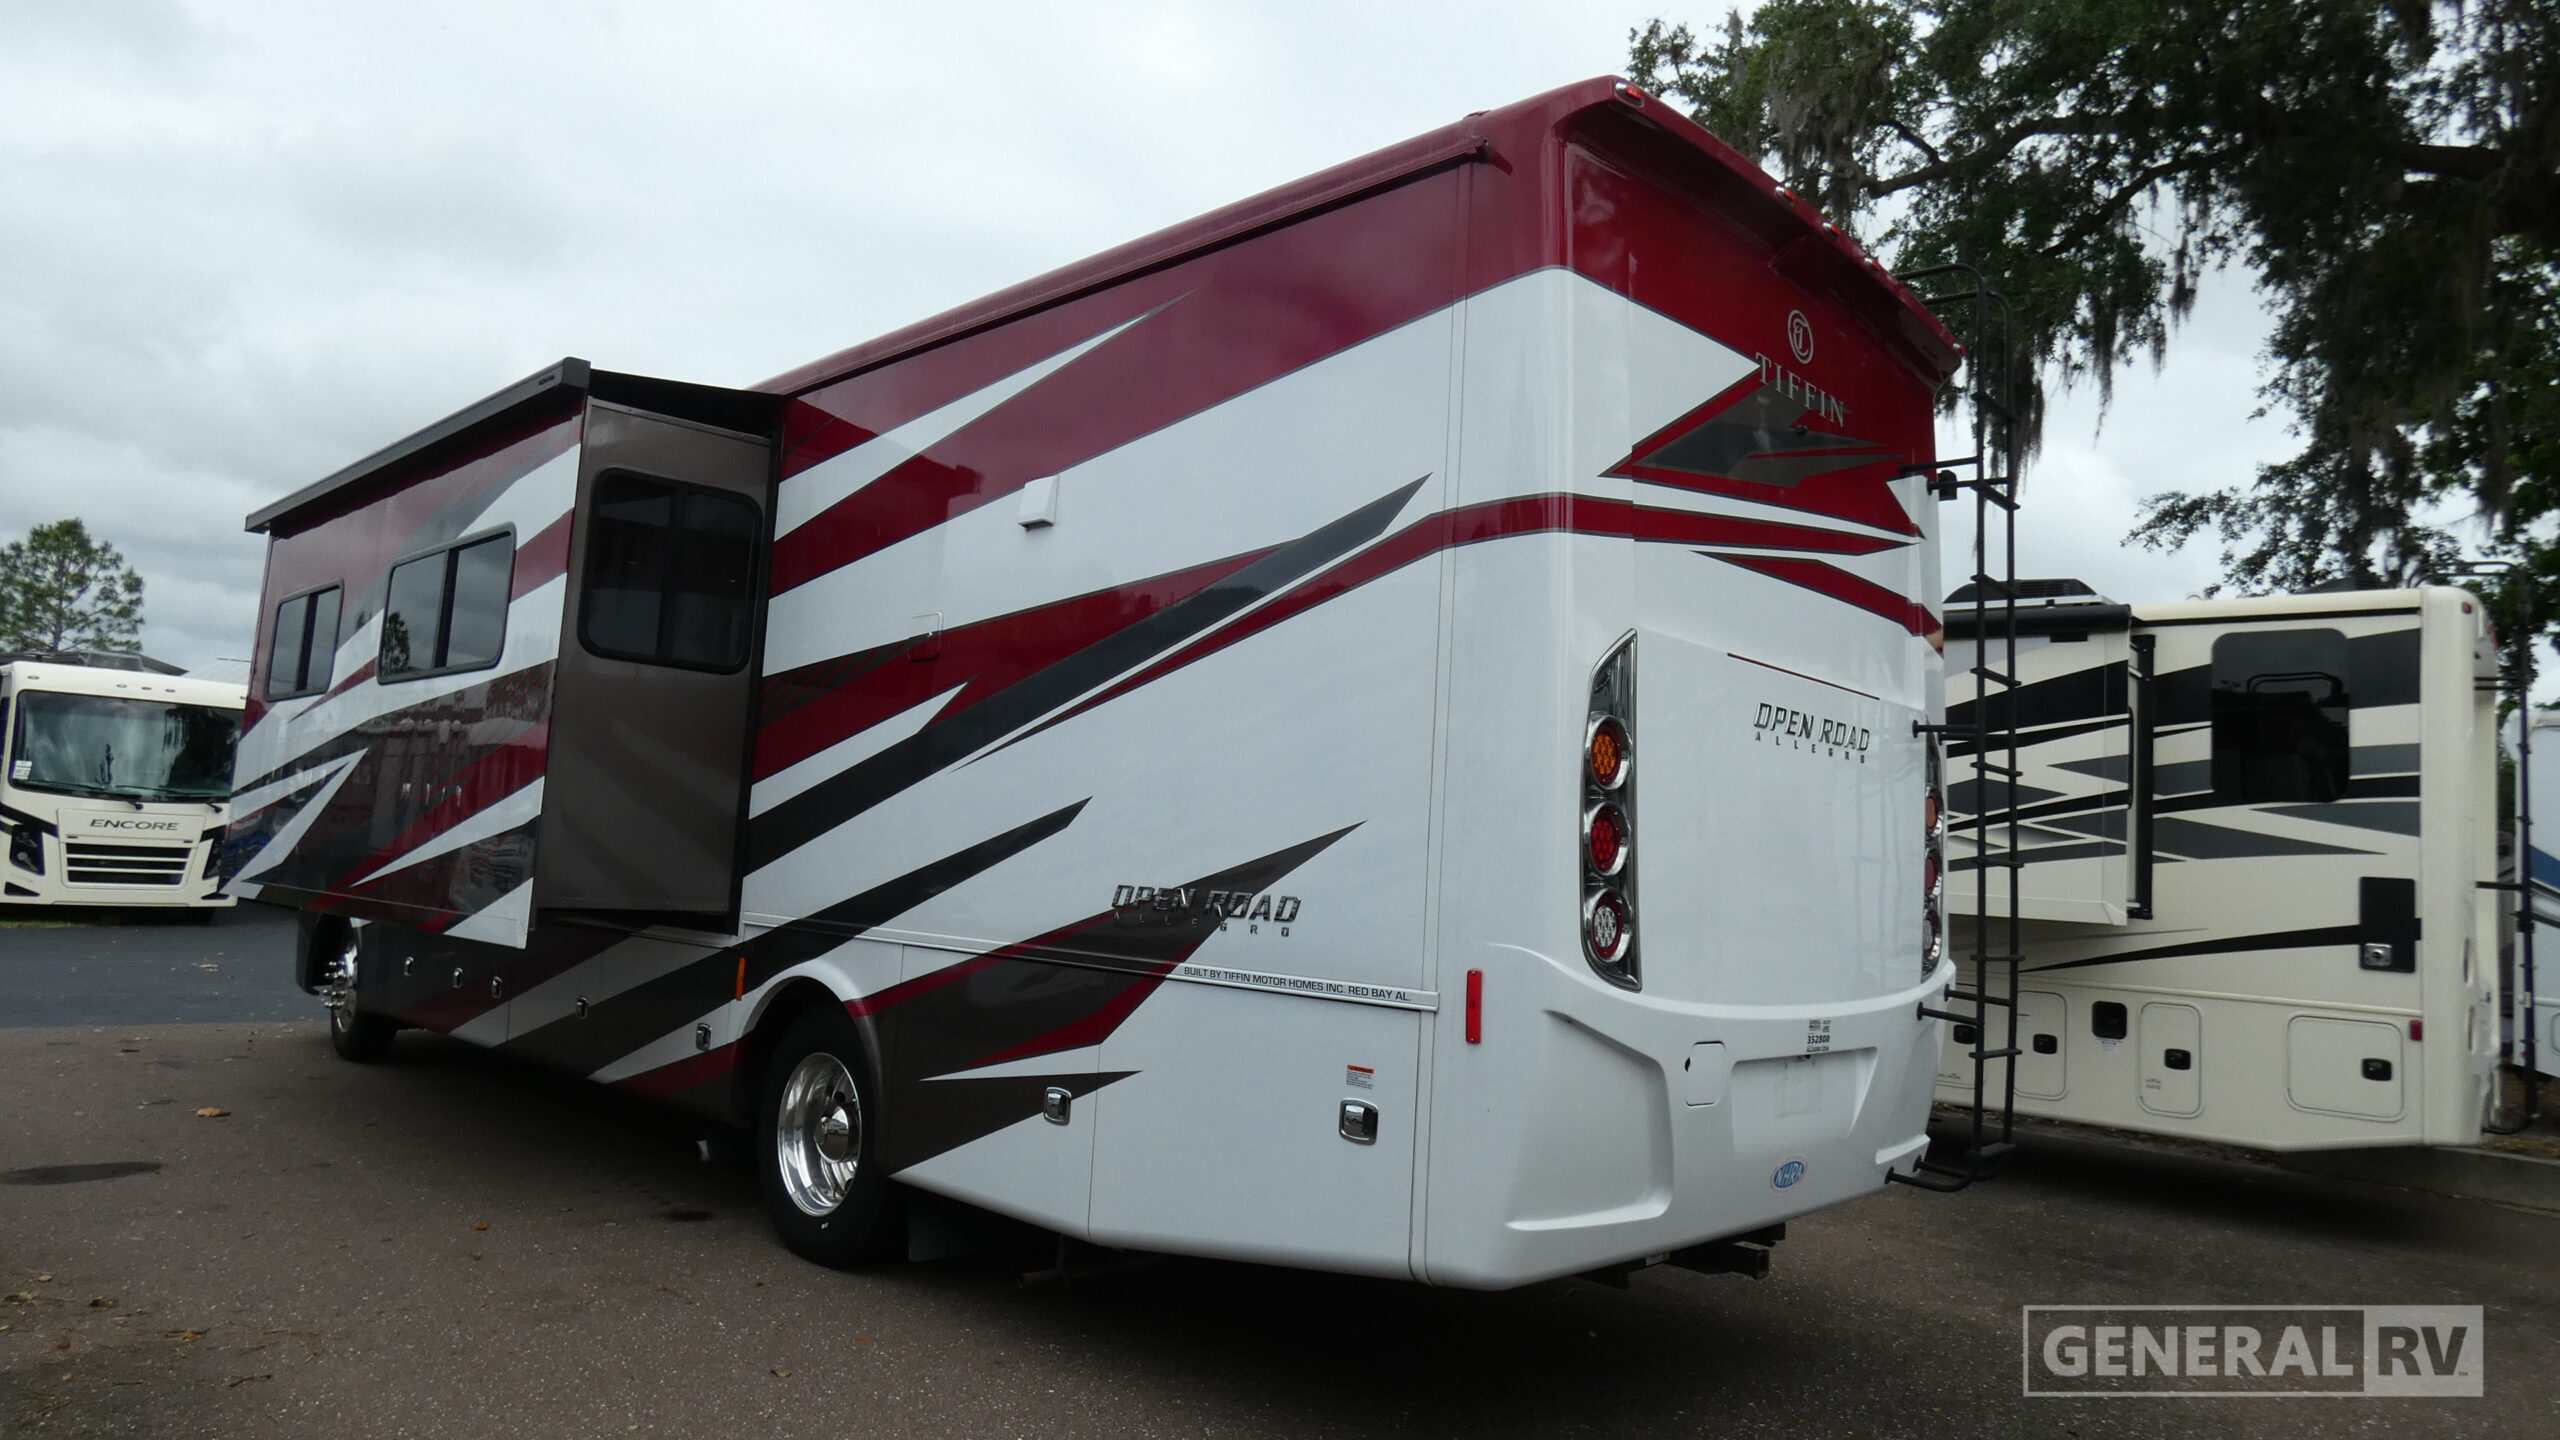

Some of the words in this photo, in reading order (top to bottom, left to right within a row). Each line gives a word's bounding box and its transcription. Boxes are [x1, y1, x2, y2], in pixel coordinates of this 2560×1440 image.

[1755, 351, 1844, 428] TIFFIN
[1754, 702, 1814, 739] OPEN
[1818, 718, 1870, 751] ROAD
[89, 819, 180, 831] ENCORE
[1111, 884, 1196, 911] OPEN
[1203, 890, 1301, 922] ROAD
[1113, 911, 1290, 937] ALLEGRO
[1184, 966, 1208, 977] BUILT
[1209, 969, 1222, 979] BY
[1224, 971, 1251, 983] TIFFIN
[1252, 975, 1286, 987] MOTOR
[1288, 979, 1324, 991] HOMES
[1326, 983, 1345, 994] INC.
[1348, 985, 1369, 997] RED
[1371, 988, 1393, 999] BAY
[1395, 991, 1411, 1002] AL.
